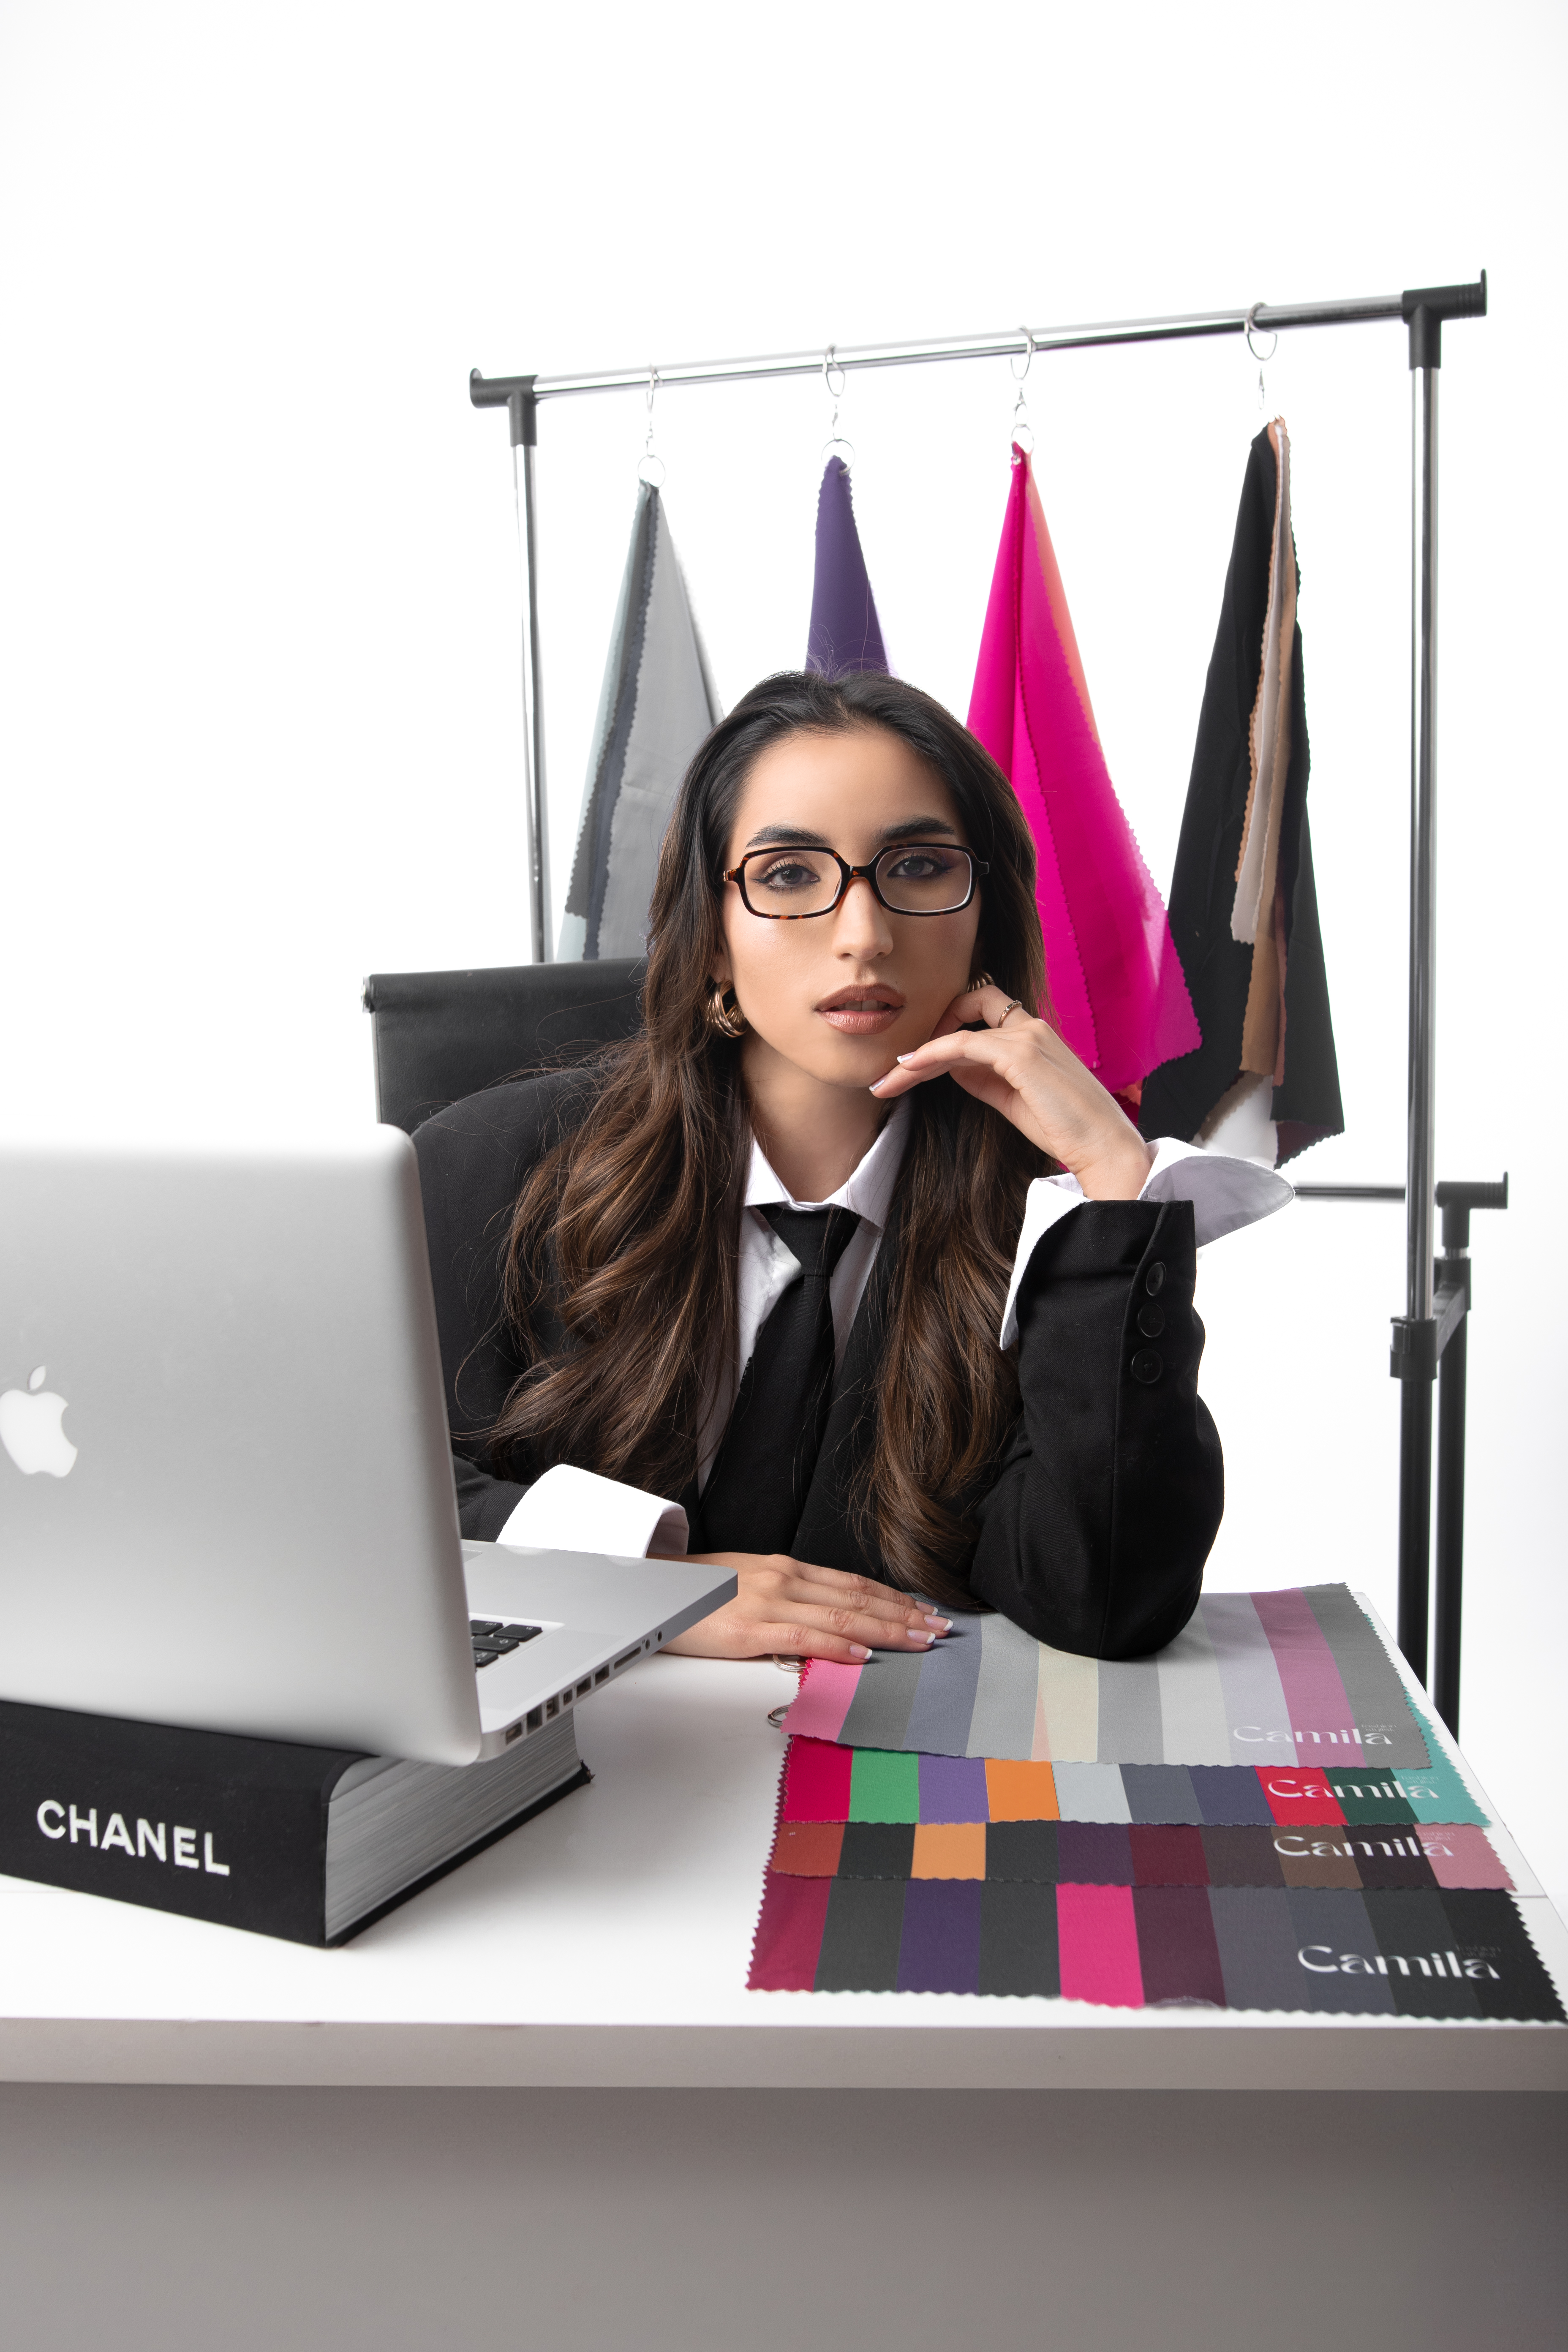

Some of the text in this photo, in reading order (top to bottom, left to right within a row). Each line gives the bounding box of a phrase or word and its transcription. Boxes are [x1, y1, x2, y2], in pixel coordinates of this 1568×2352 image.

[1233, 1726, 1393, 1745] Camila
[1268, 1780, 1439, 1798] Camila
[37, 1799, 230, 1876] CHANEL
[1274, 1836, 1454, 1857] Camila
[1298, 1945, 1500, 1979] Camila
